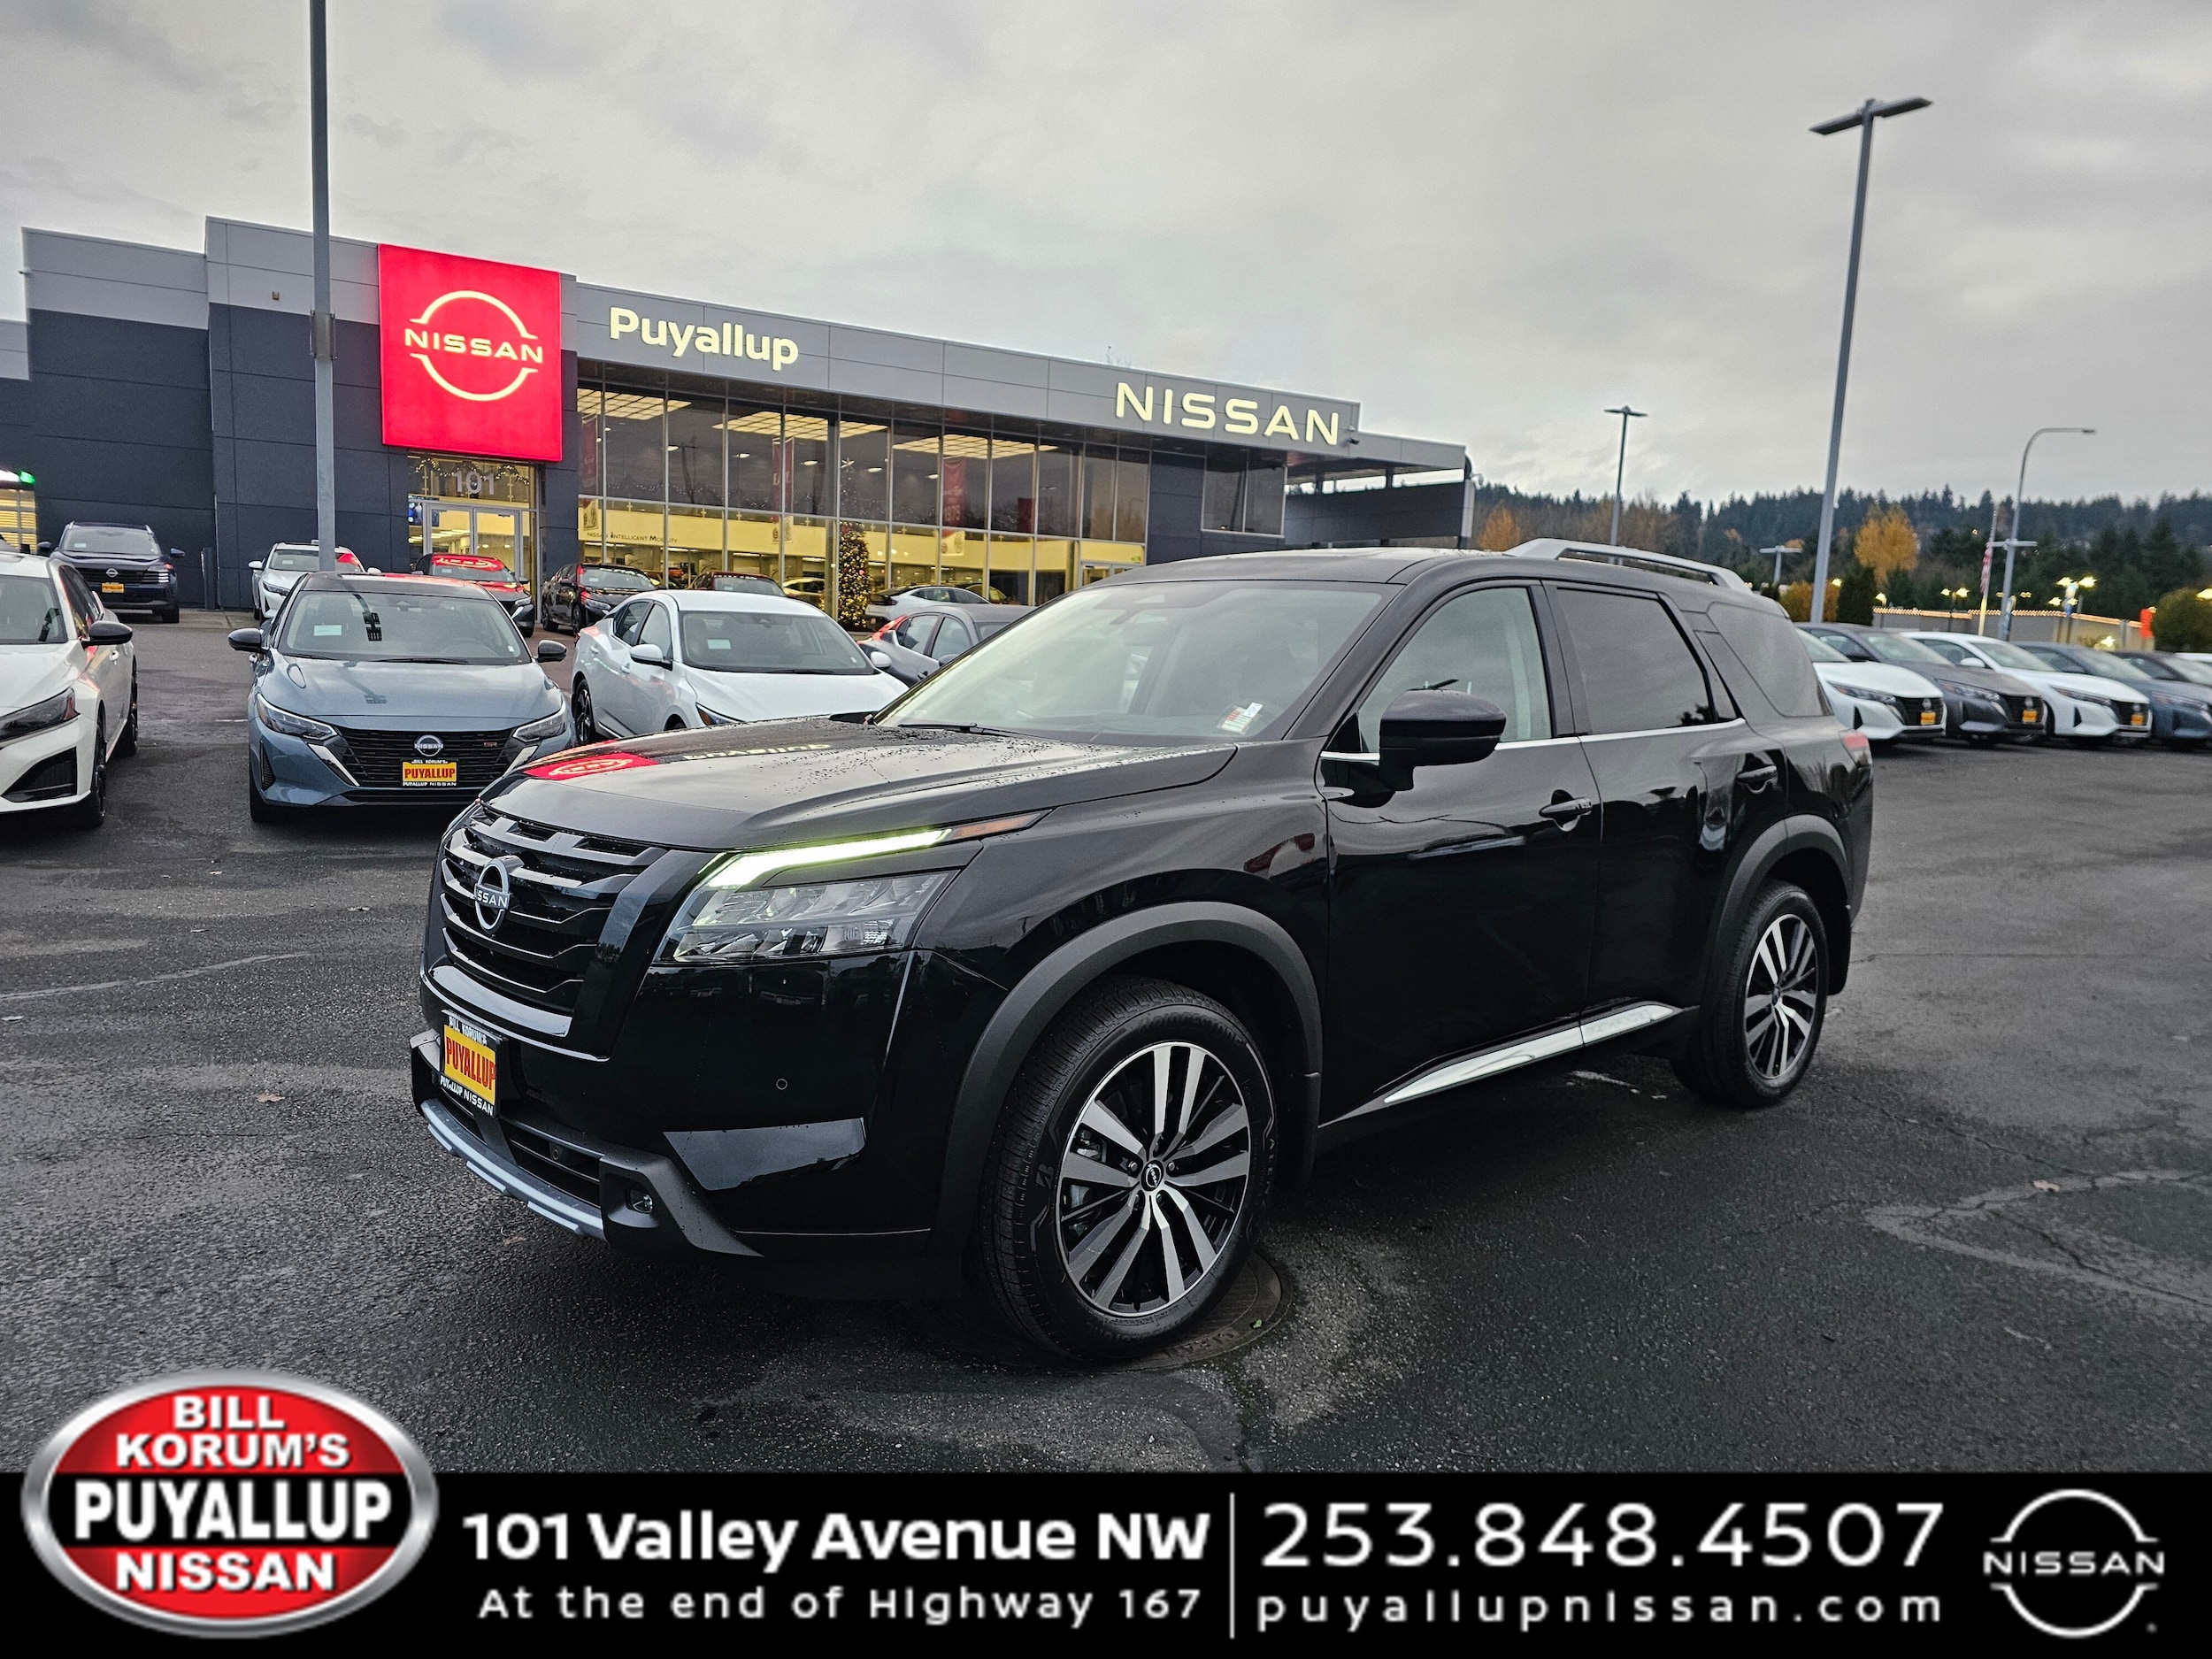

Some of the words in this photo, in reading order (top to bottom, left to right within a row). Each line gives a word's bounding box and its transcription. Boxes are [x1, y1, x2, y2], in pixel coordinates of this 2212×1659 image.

[404, 327, 543, 364] NISSAN
[610, 306, 799, 372] Puyallup
[1116, 381, 1340, 446] NISSAN
[454, 470, 495, 495] 101
[404, 768, 456, 779] PUYALLUP
[475, 889, 508, 908] SSAN
[449, 1016, 460, 1033] BILL
[445, 1035, 496, 1090] PUYALLUP
[440, 1075, 463, 1096] PUYALLUP
[464, 1089, 494, 1116] NISSAN
